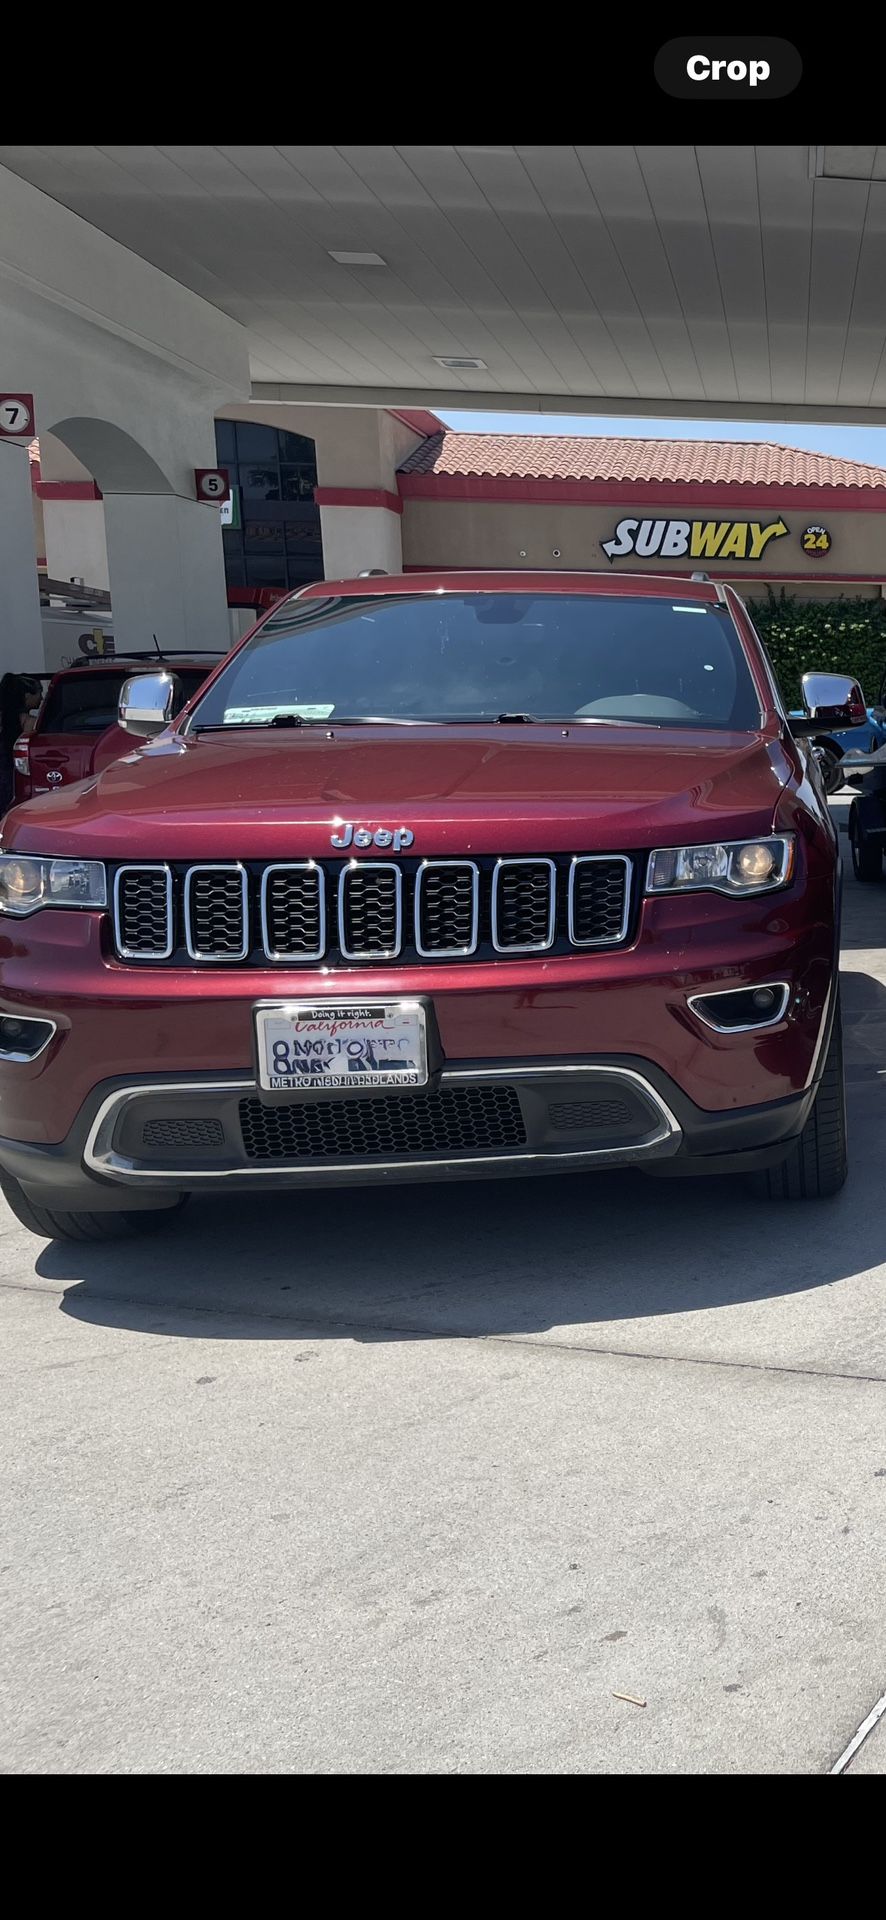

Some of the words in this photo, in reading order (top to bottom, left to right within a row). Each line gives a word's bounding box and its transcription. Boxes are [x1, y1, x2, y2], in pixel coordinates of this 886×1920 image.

[4, 407, 19, 424] 7
[208, 478, 219, 492] 5
[807, 526, 826, 535] OPEN
[602, 518, 789, 560] SUBWAY
[804, 533, 829, 549] 24
[330, 823, 415, 851] Jeep
[311, 1009, 335, 1020] Doing
[337, 1009, 346, 1018] it
[347, 1009, 372, 1019] right.
[295, 1018, 395, 1036] California
[271, 1076, 312, 1087] METRO
